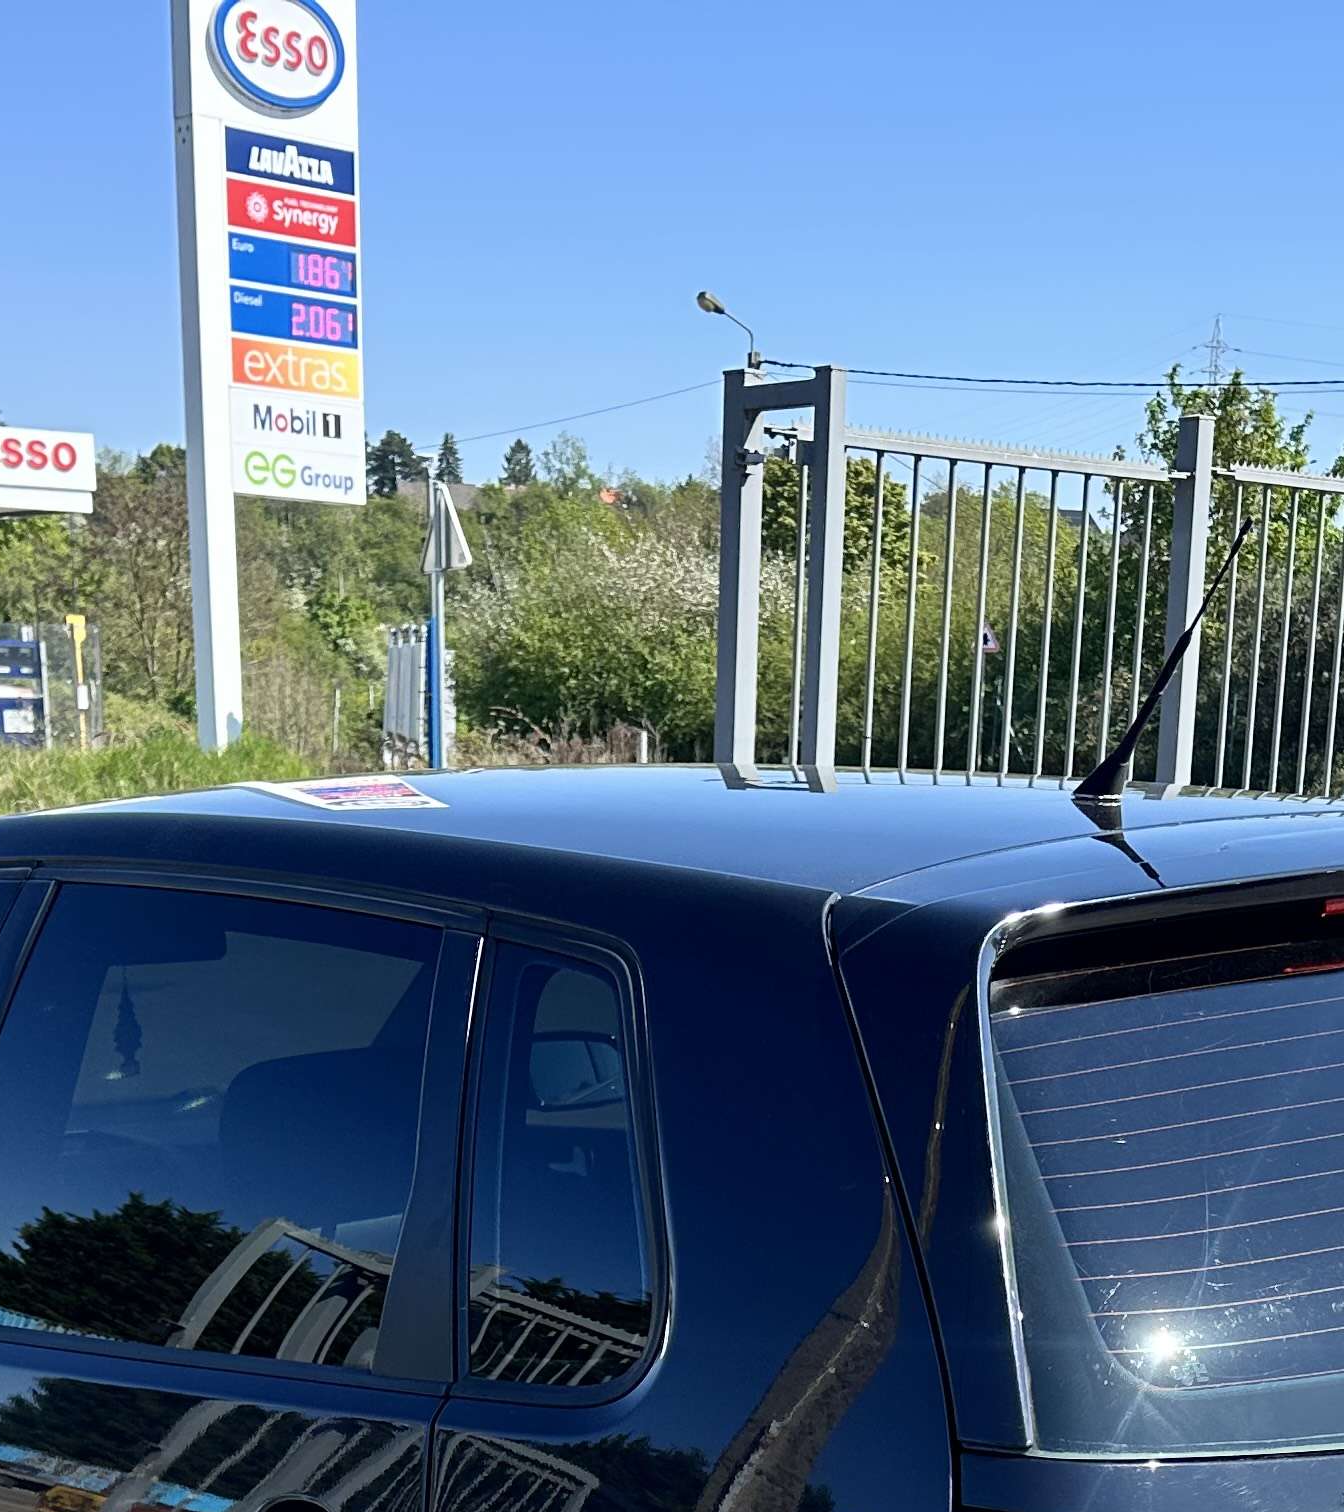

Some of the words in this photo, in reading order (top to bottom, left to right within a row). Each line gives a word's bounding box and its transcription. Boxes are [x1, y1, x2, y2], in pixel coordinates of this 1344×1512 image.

[272, 199, 339, 236] Synergy
[233, 290, 263, 307] Diesel
[243, 348, 351, 392] extras
[253, 404, 317, 437] Mobil
[323, 412, 342, 439] 1
[301, 466, 355, 495] Group
